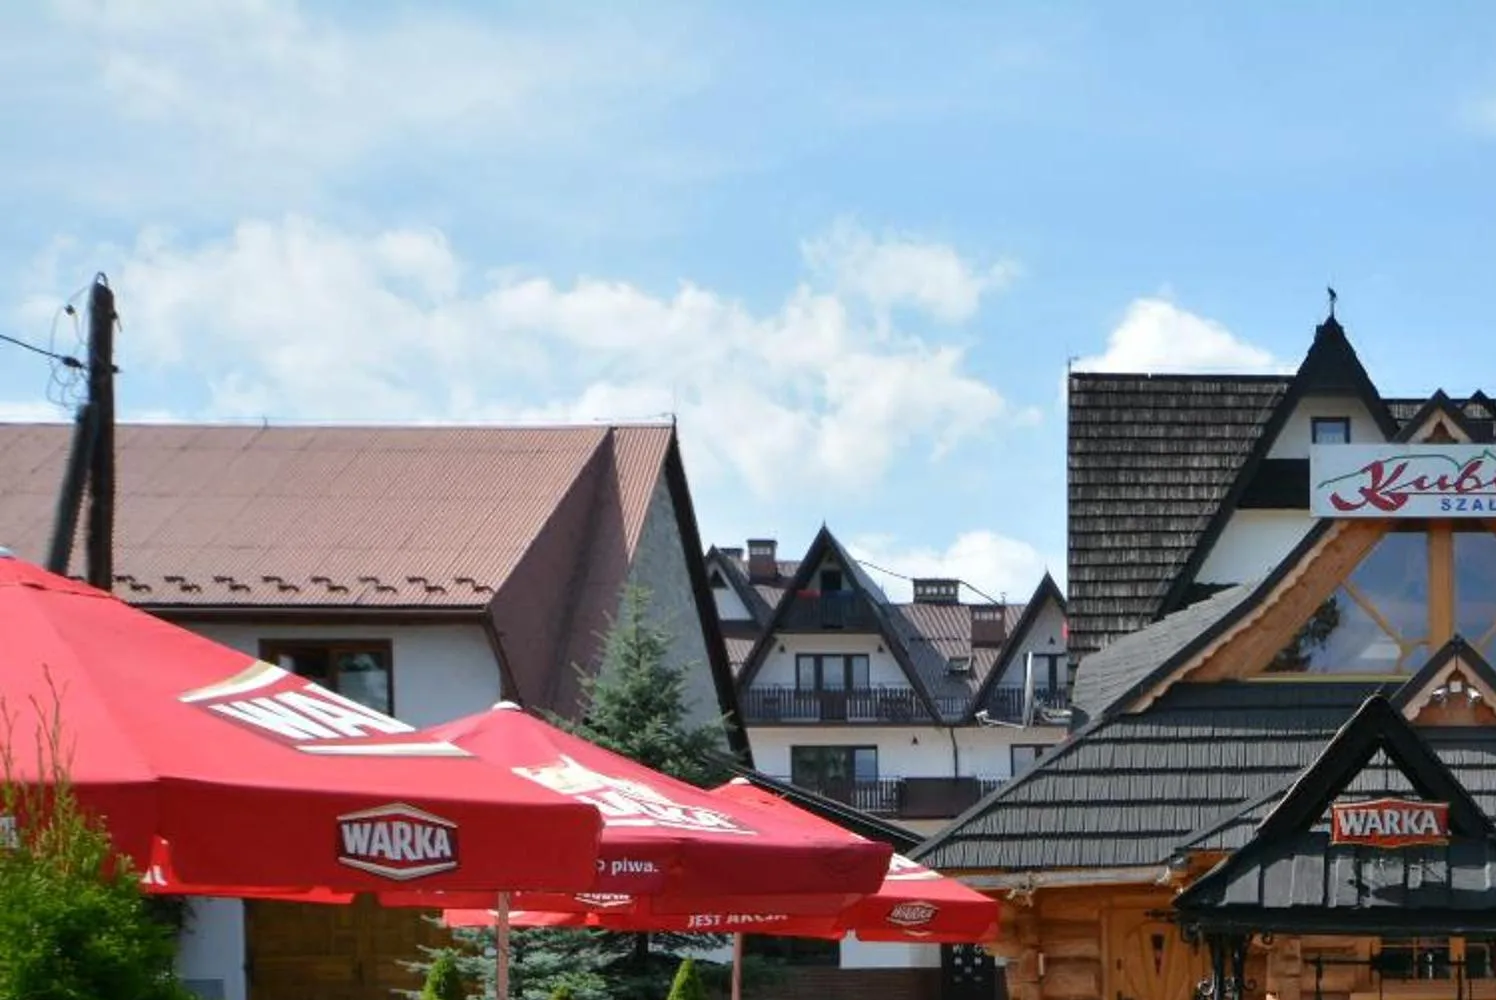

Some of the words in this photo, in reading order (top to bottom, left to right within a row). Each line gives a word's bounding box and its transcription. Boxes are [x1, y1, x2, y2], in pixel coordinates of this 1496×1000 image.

[1338, 808, 1440, 837] WARKA
[341, 820, 452, 861] WARKA
[611, 857, 660, 876] piwa.
